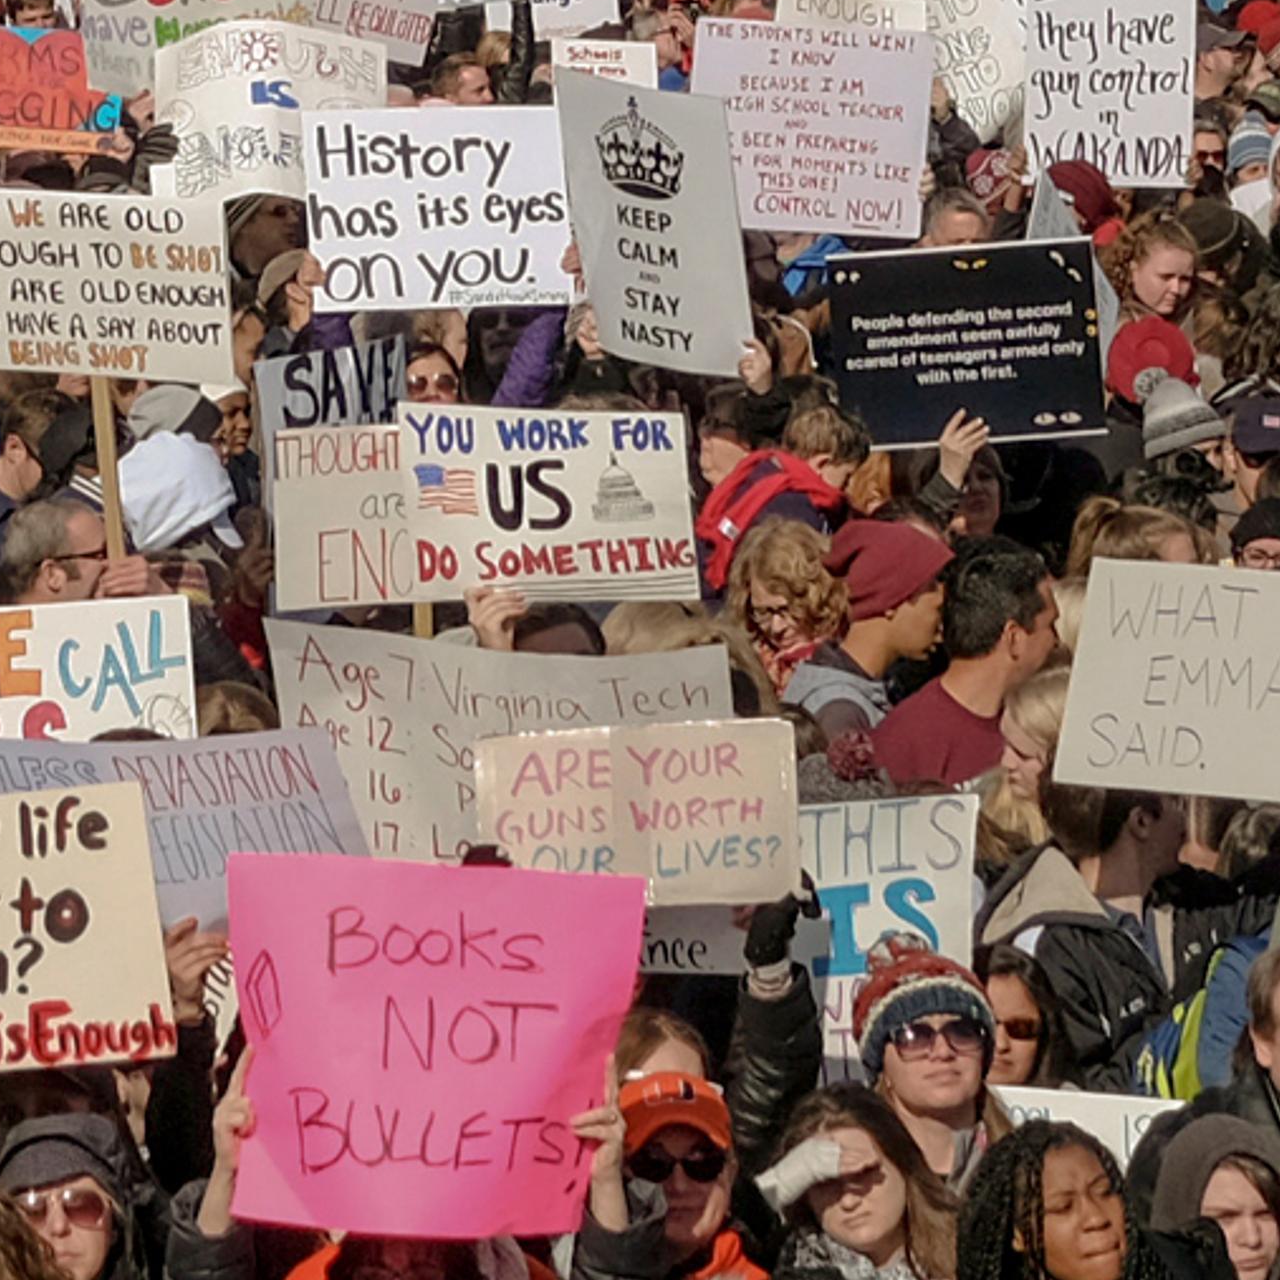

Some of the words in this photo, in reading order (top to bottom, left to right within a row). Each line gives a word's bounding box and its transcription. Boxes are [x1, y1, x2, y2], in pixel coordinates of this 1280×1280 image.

[1036, 12, 1098, 59] they
[1107, 9, 1175, 48] have
[318, 122, 511, 186] History
[9, 199, 44, 228] WE
[59, 202, 110, 228] ARE
[126, 206, 184, 234] OLD
[310, 194, 398, 239] has
[418, 192, 468, 229] its
[484, 190, 565, 229] eyes
[617, 205, 672, 233] KEEP
[90, 242, 122, 268] TO
[130, 245, 156, 270] BE
[166, 245, 224, 272] SHOT
[324, 256, 402, 301] on
[418, 248, 536, 302] you.
[617, 237, 679, 268] CALM
[624, 285, 680, 317] STAY
[852, 314, 904, 332] People
[907, 309, 985, 327] defending
[988, 306, 1013, 321] the
[1016, 302, 1073, 319] second
[621, 319, 693, 354] NASTY
[846, 354, 897, 370] scared
[901, 351, 916, 365] of
[920, 347, 997, 365] teenagers
[1000, 342, 1050, 358] armed
[1052, 339, 1085, 357] only
[408, 413, 475, 454] YOU
[498, 418, 589, 450] WORK
[612, 416, 673, 450] FOR
[485, 460, 572, 530] US
[416, 538, 458, 583] DO
[476, 538, 697, 579] SOMETHING
[1109, 579, 1259, 640] WHAT
[57, 609, 186, 717] CALL
[432, 662, 586, 721] Virginia
[600, 677, 709, 716] Tech
[1087, 714, 1207, 769] SAID.
[512, 749, 611, 797] ARE
[628, 743, 741, 785] YOUR
[19, 795, 109, 858] life
[495, 806, 606, 843] GUNS
[630, 798, 763, 832] WORTH
[656, 836, 782, 877] LIVES?
[11, 879, 89, 941] to
[383, 996, 558, 1072] NOT
